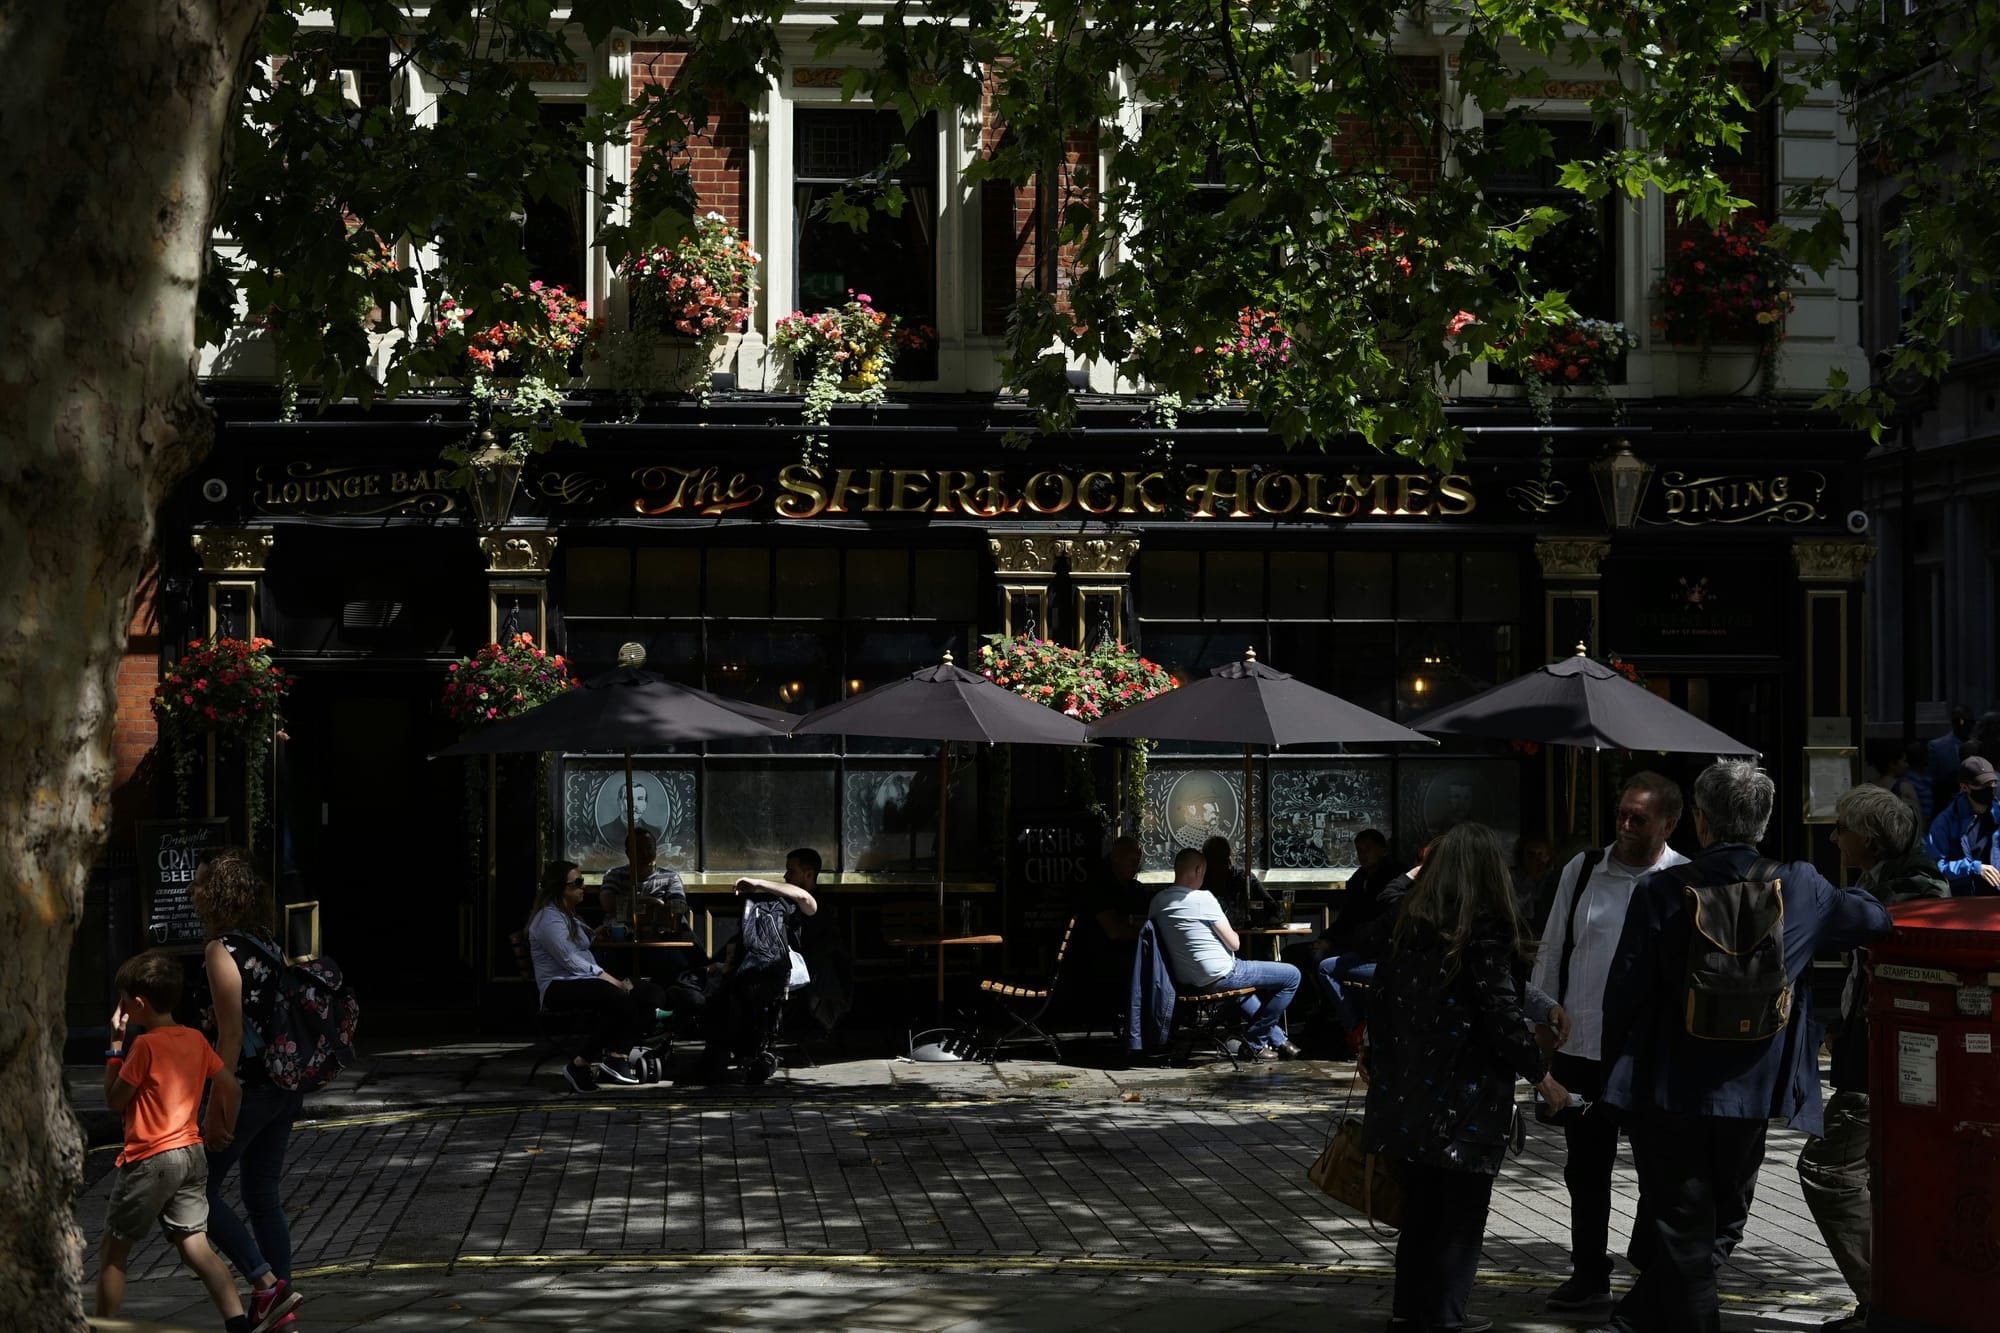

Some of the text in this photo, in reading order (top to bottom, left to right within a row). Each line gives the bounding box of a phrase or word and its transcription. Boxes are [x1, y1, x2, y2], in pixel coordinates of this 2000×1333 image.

[265, 472, 381, 504] LOUNGE
[632, 463, 1478, 519] The SHERLOCK HOLMES
[1664, 475, 1789, 514] DINING
[1024, 825, 1087, 854] FISH &
[1024, 856, 1089, 883] CHIPS
[1882, 965, 1945, 982] STAMPED MAIL
